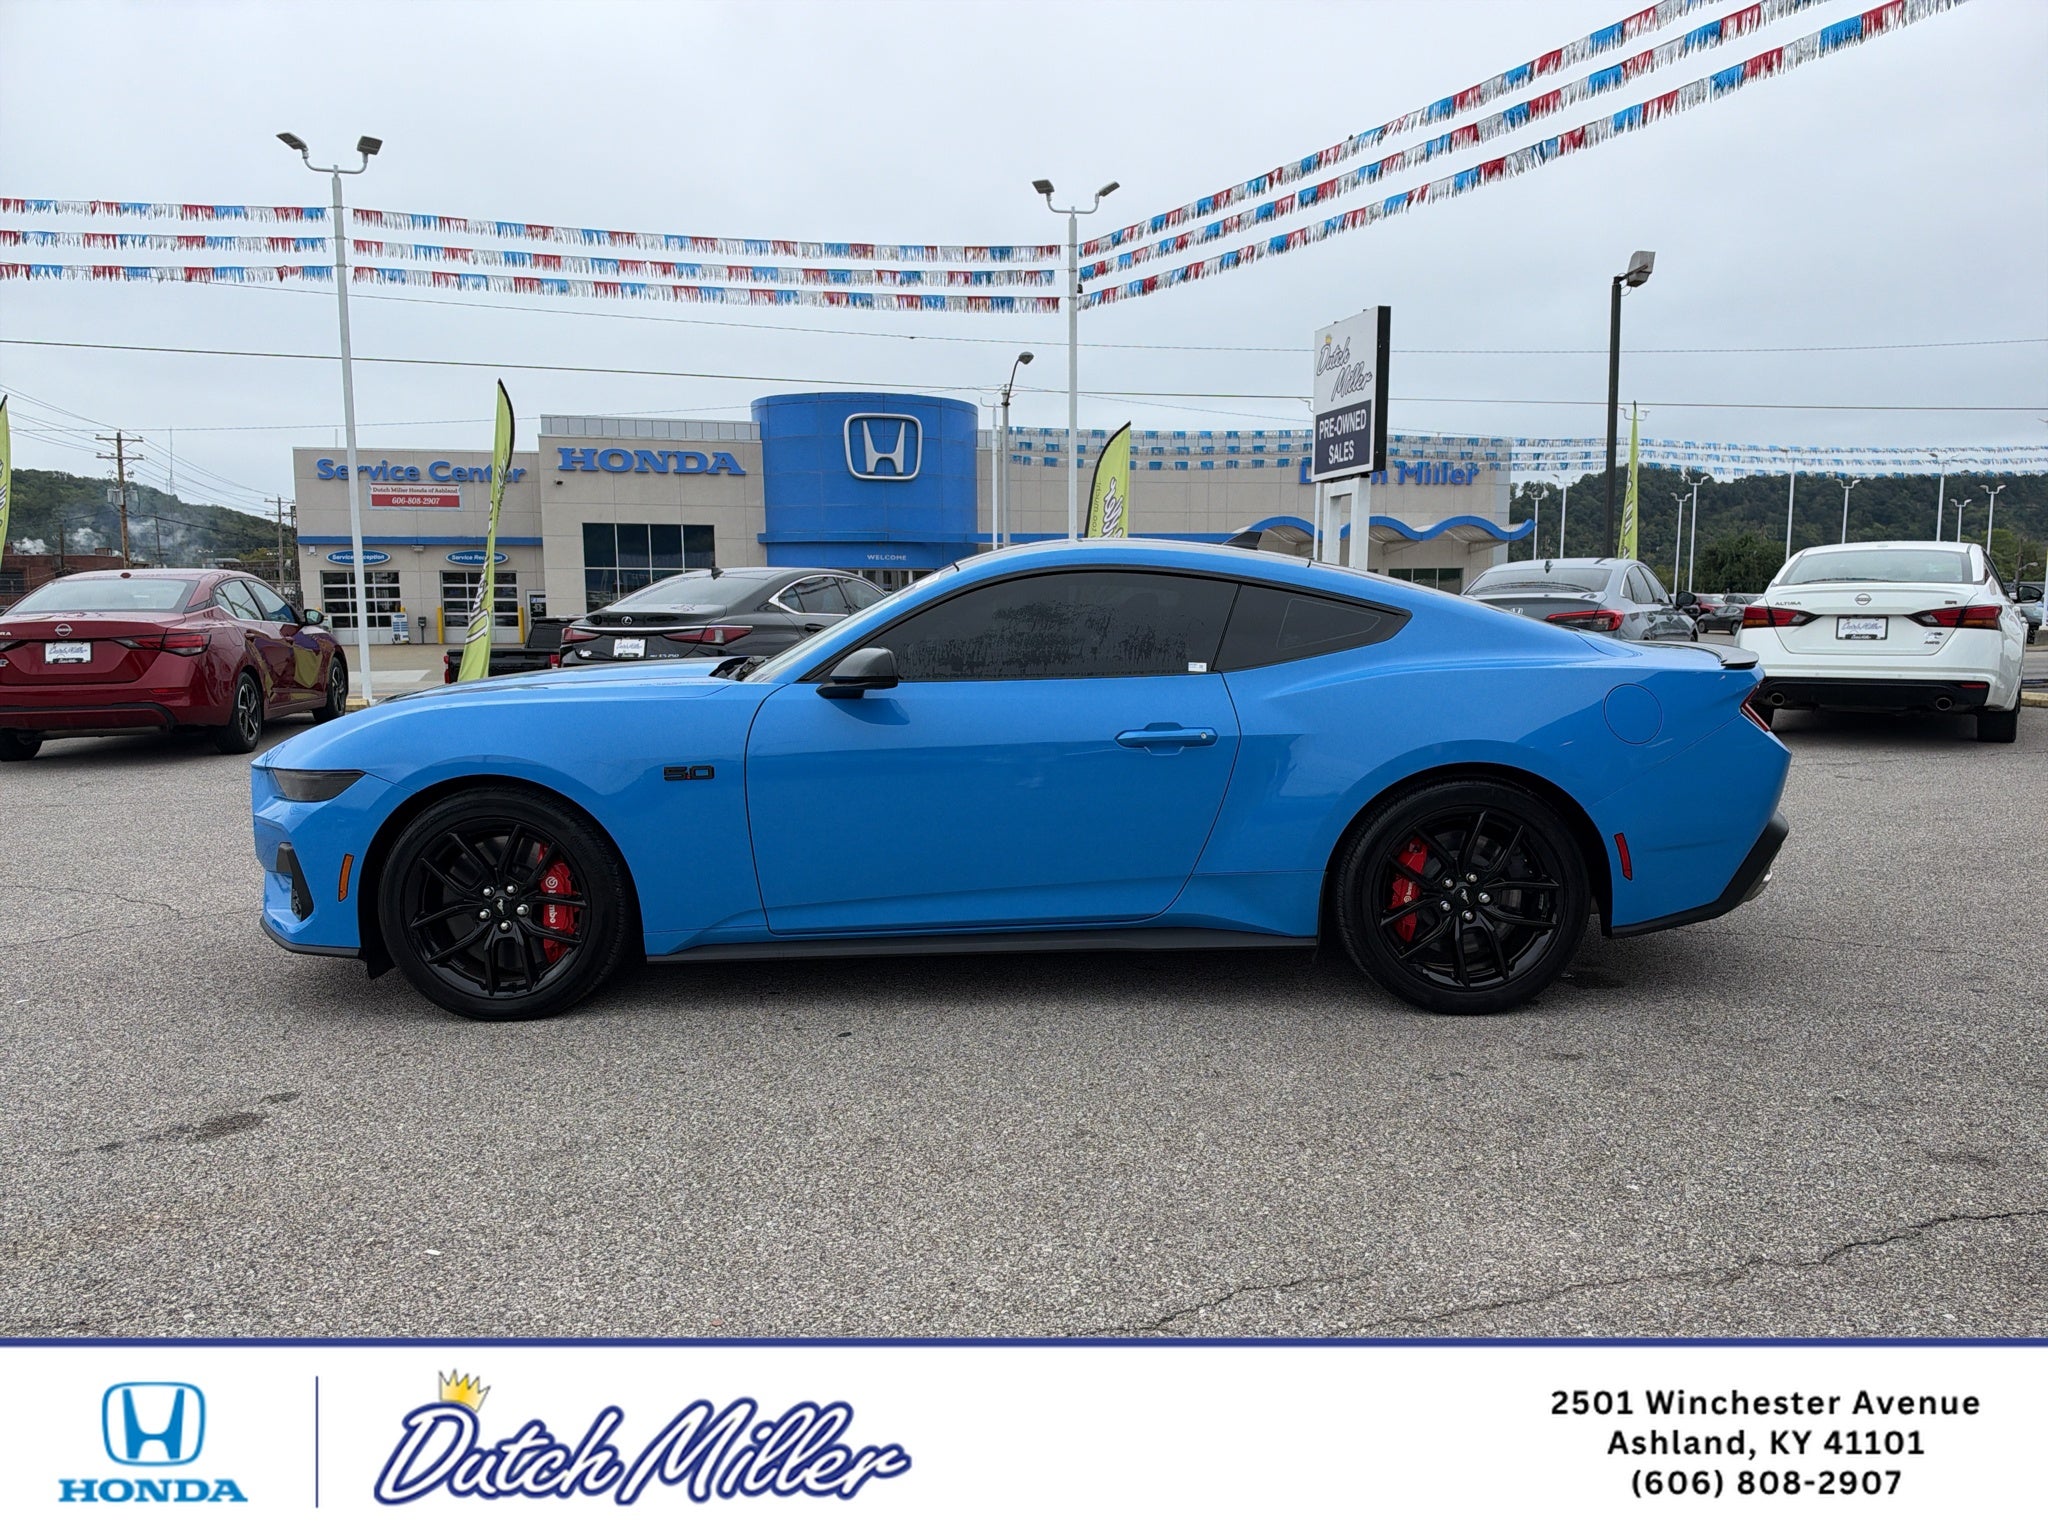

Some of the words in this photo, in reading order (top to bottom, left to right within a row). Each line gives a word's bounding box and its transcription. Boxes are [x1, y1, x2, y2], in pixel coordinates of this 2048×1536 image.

[1316, 336, 1351, 376] Dutch
[1330, 361, 1373, 402] Miller
[1318, 408, 1367, 441] PRE-OWNED
[557, 447, 747, 475] HONDA
[1328, 439, 1355, 464] SALES
[316, 458, 420, 481] Service
[663, 765, 715, 781] 5.0
